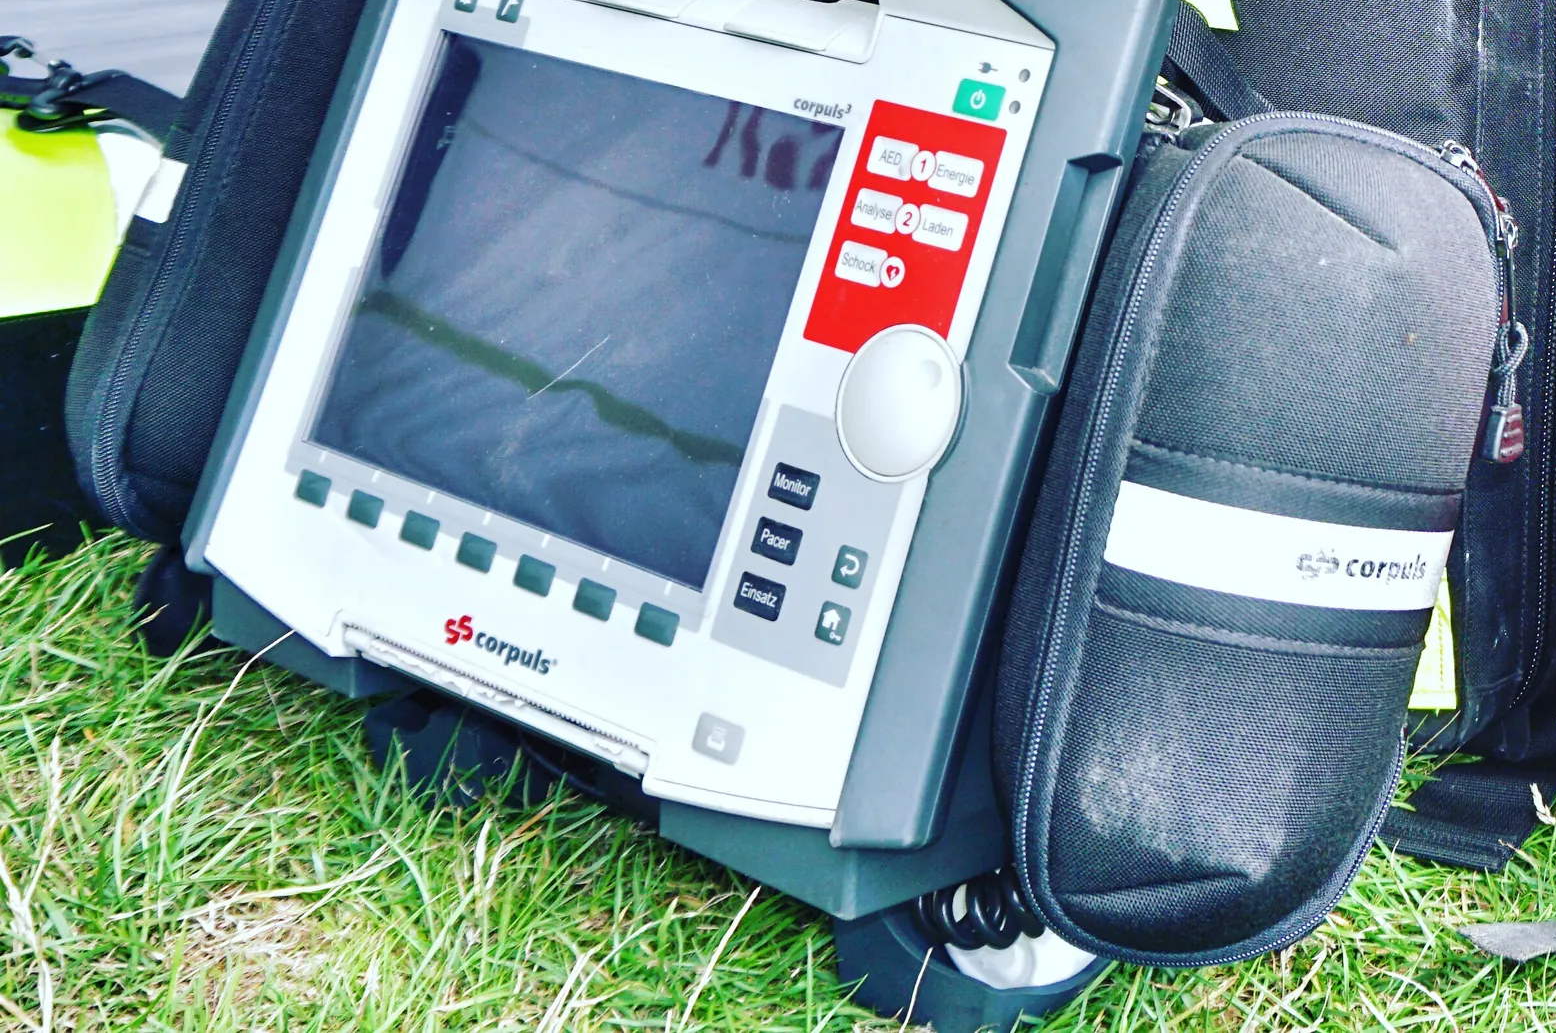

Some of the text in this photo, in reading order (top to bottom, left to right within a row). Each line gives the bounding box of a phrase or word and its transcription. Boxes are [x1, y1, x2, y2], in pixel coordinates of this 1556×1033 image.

[878, 148, 976, 187] AED 1 Energie
[855, 198, 954, 238] Analyse 2 Laden
[840, 251, 876, 275] Schock
[773, 472, 813, 498] Monitor
[759, 527, 791, 552] Pacer
[1345, 553, 1428, 586] corpuls
[740, 581, 778, 609] Einsatz
[474, 631, 551, 676] corpuls
